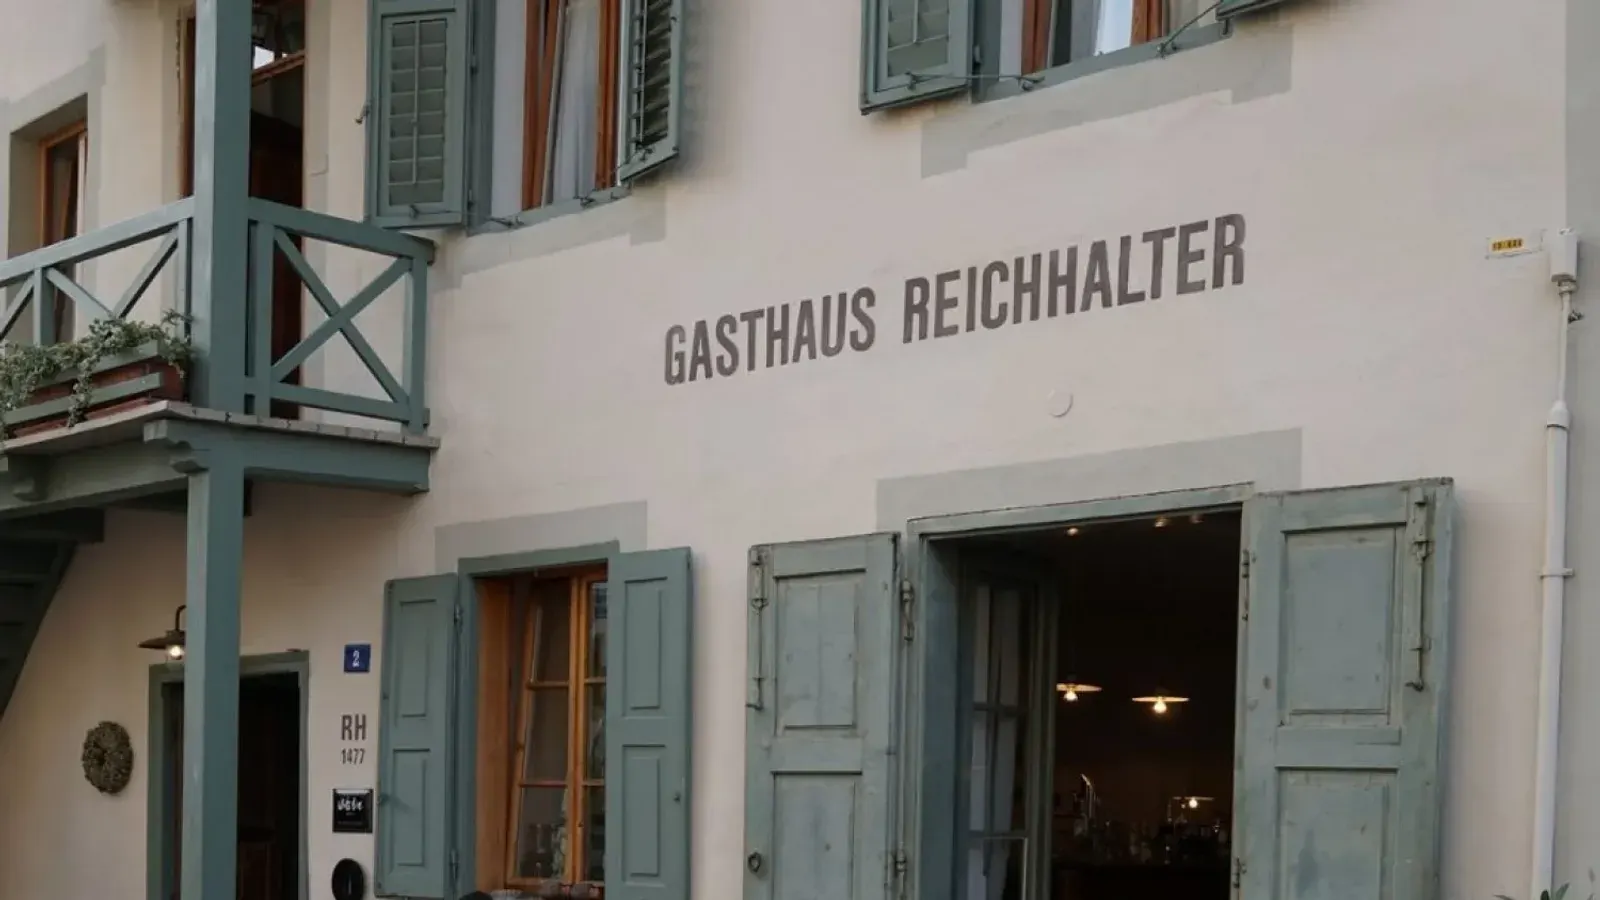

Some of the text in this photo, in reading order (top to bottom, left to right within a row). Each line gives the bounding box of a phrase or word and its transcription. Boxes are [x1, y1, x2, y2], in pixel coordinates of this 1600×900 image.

[663, 213, 1247, 386] GASTHAUS REICHHALTER
[351, 650, 361, 668] 2
[341, 714, 366, 741] RH
[341, 748, 365, 765] 1477
